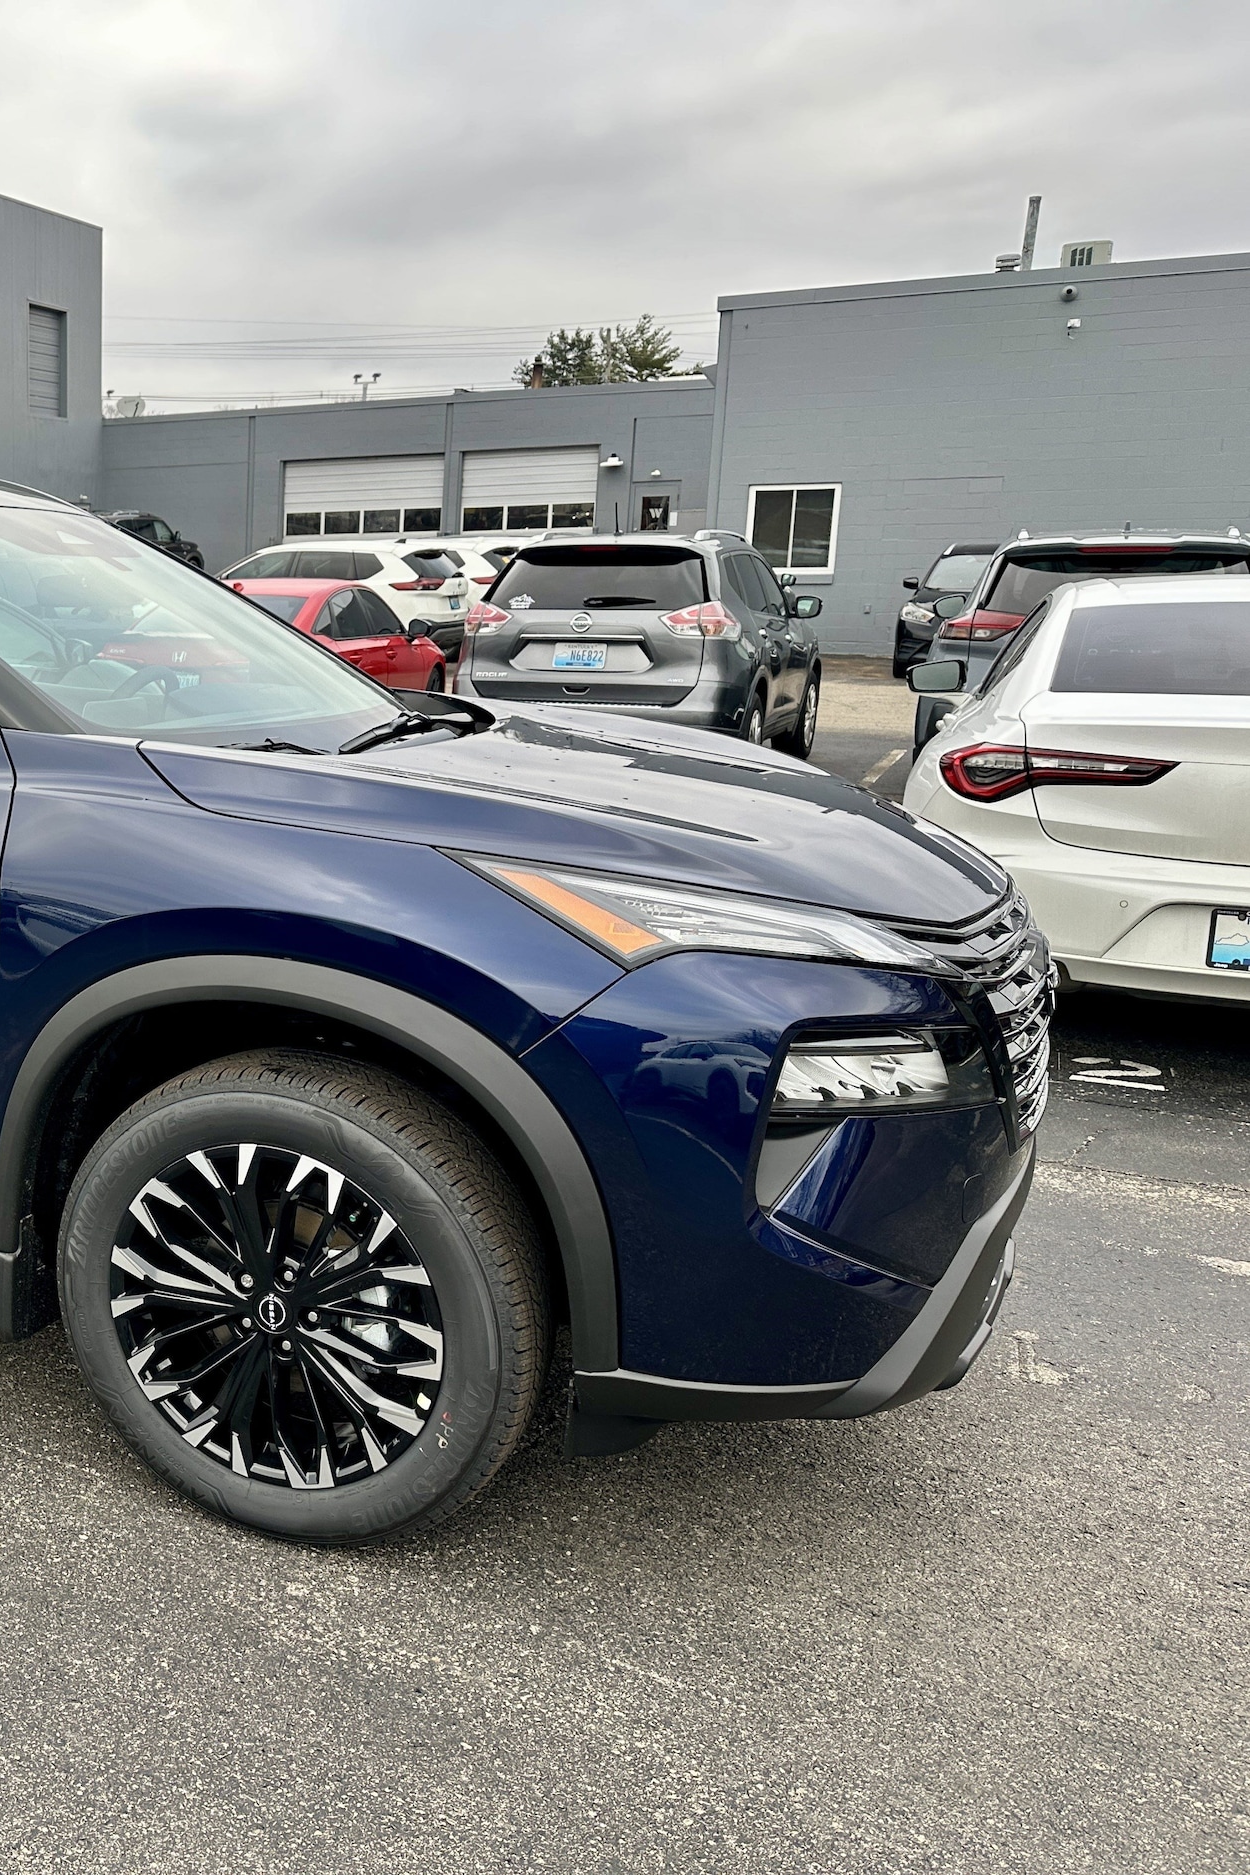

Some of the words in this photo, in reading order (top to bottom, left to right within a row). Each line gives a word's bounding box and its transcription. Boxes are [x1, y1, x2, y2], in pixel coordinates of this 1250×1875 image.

[648, 507, 664, 519] W
[570, 649, 604, 662] N6E822
[68, 1112, 179, 1270] BRIDGESTONE
[268, 1293, 277, 1331] NISSAN
